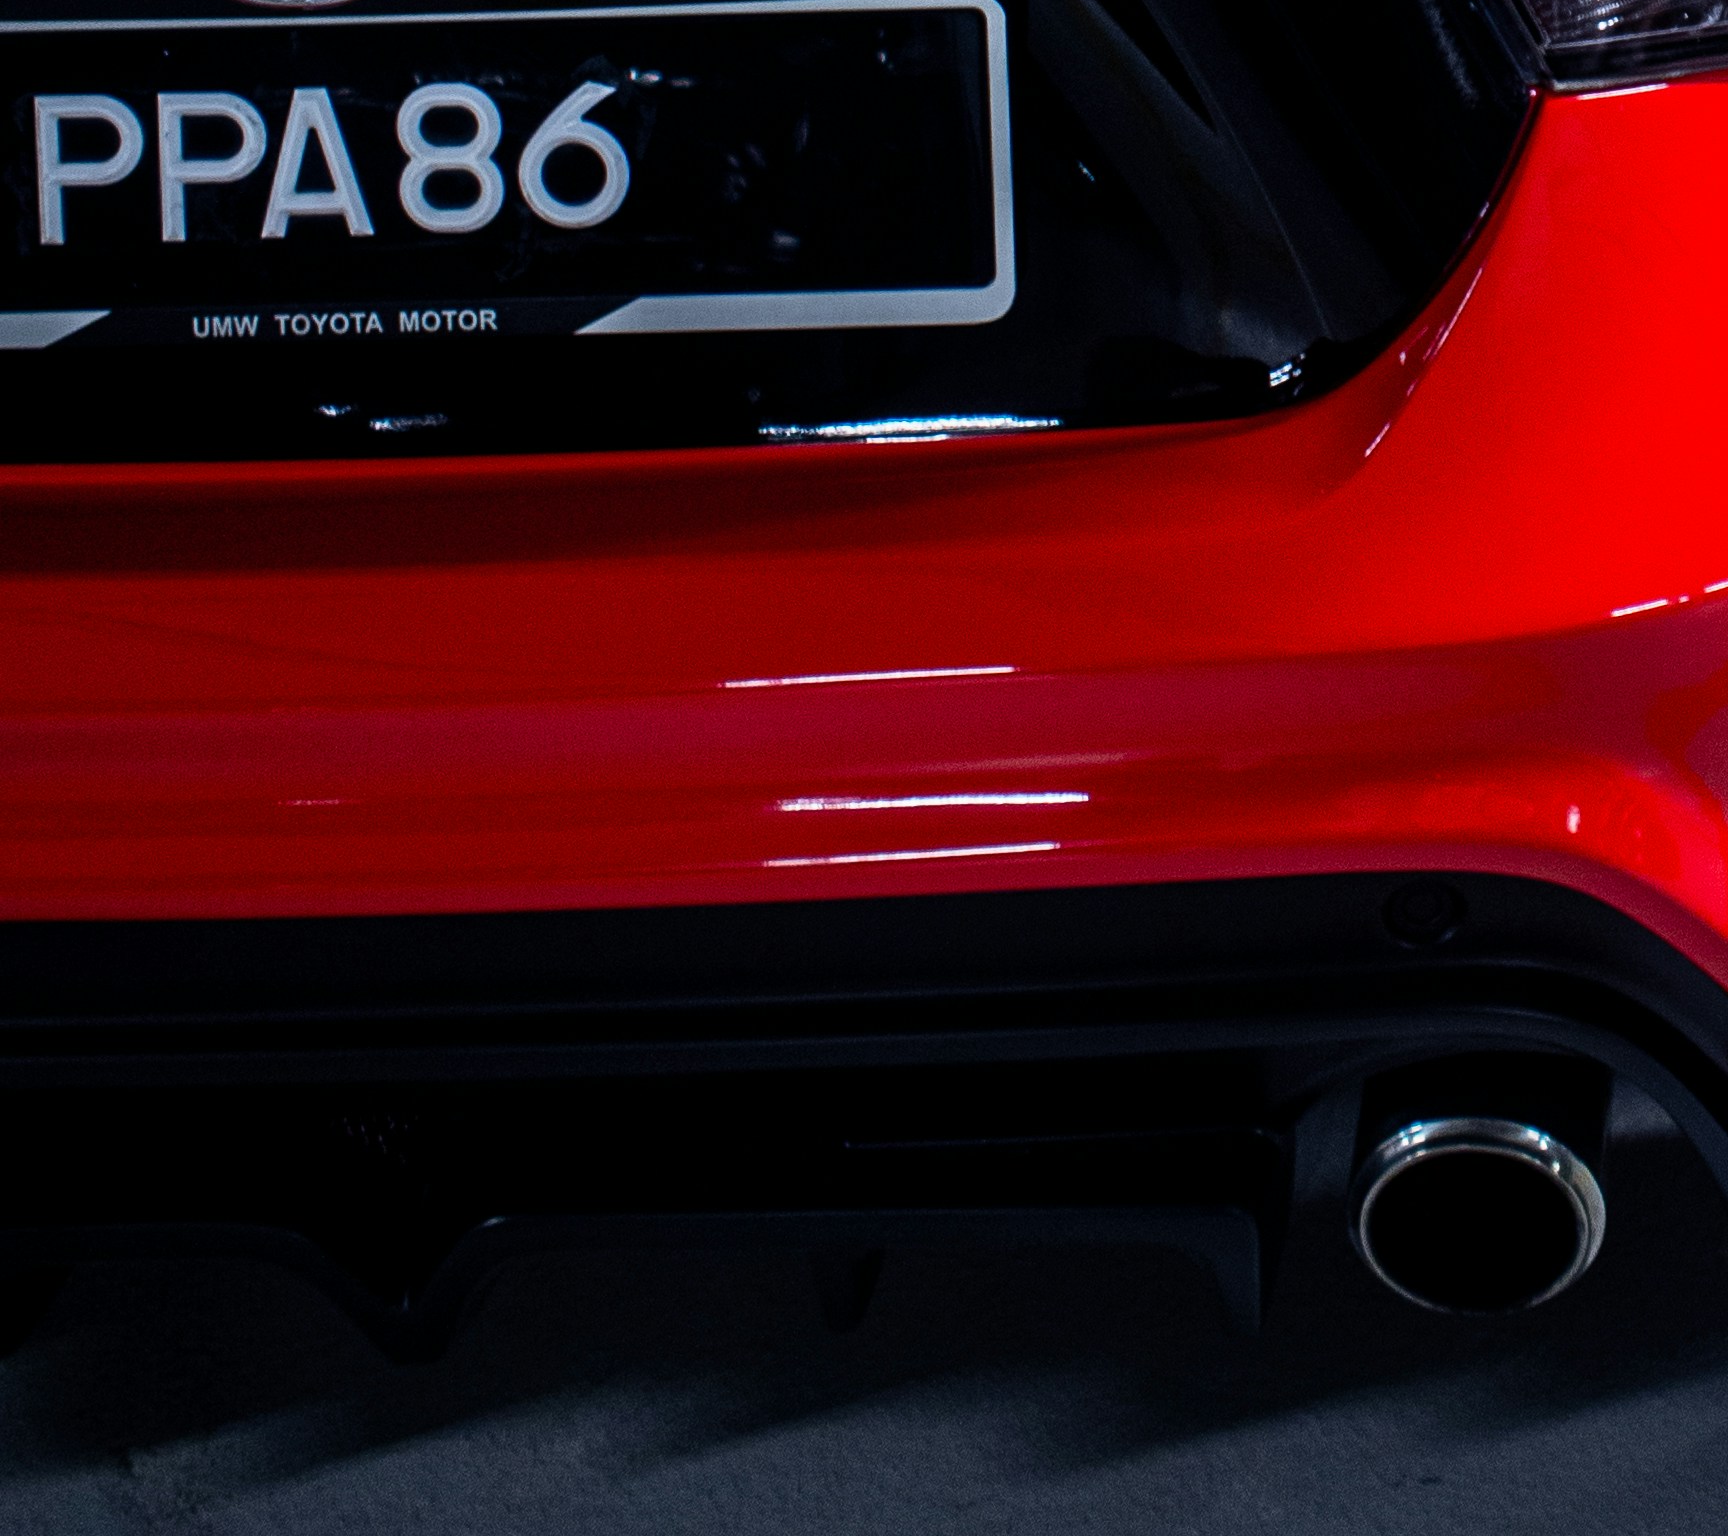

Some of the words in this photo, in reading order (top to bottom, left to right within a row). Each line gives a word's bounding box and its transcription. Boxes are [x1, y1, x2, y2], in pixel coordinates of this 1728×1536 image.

[192, 315, 259, 339] UMW
[274, 312, 383, 336] TOYOTA
[399, 309, 499, 333] MOTOR
